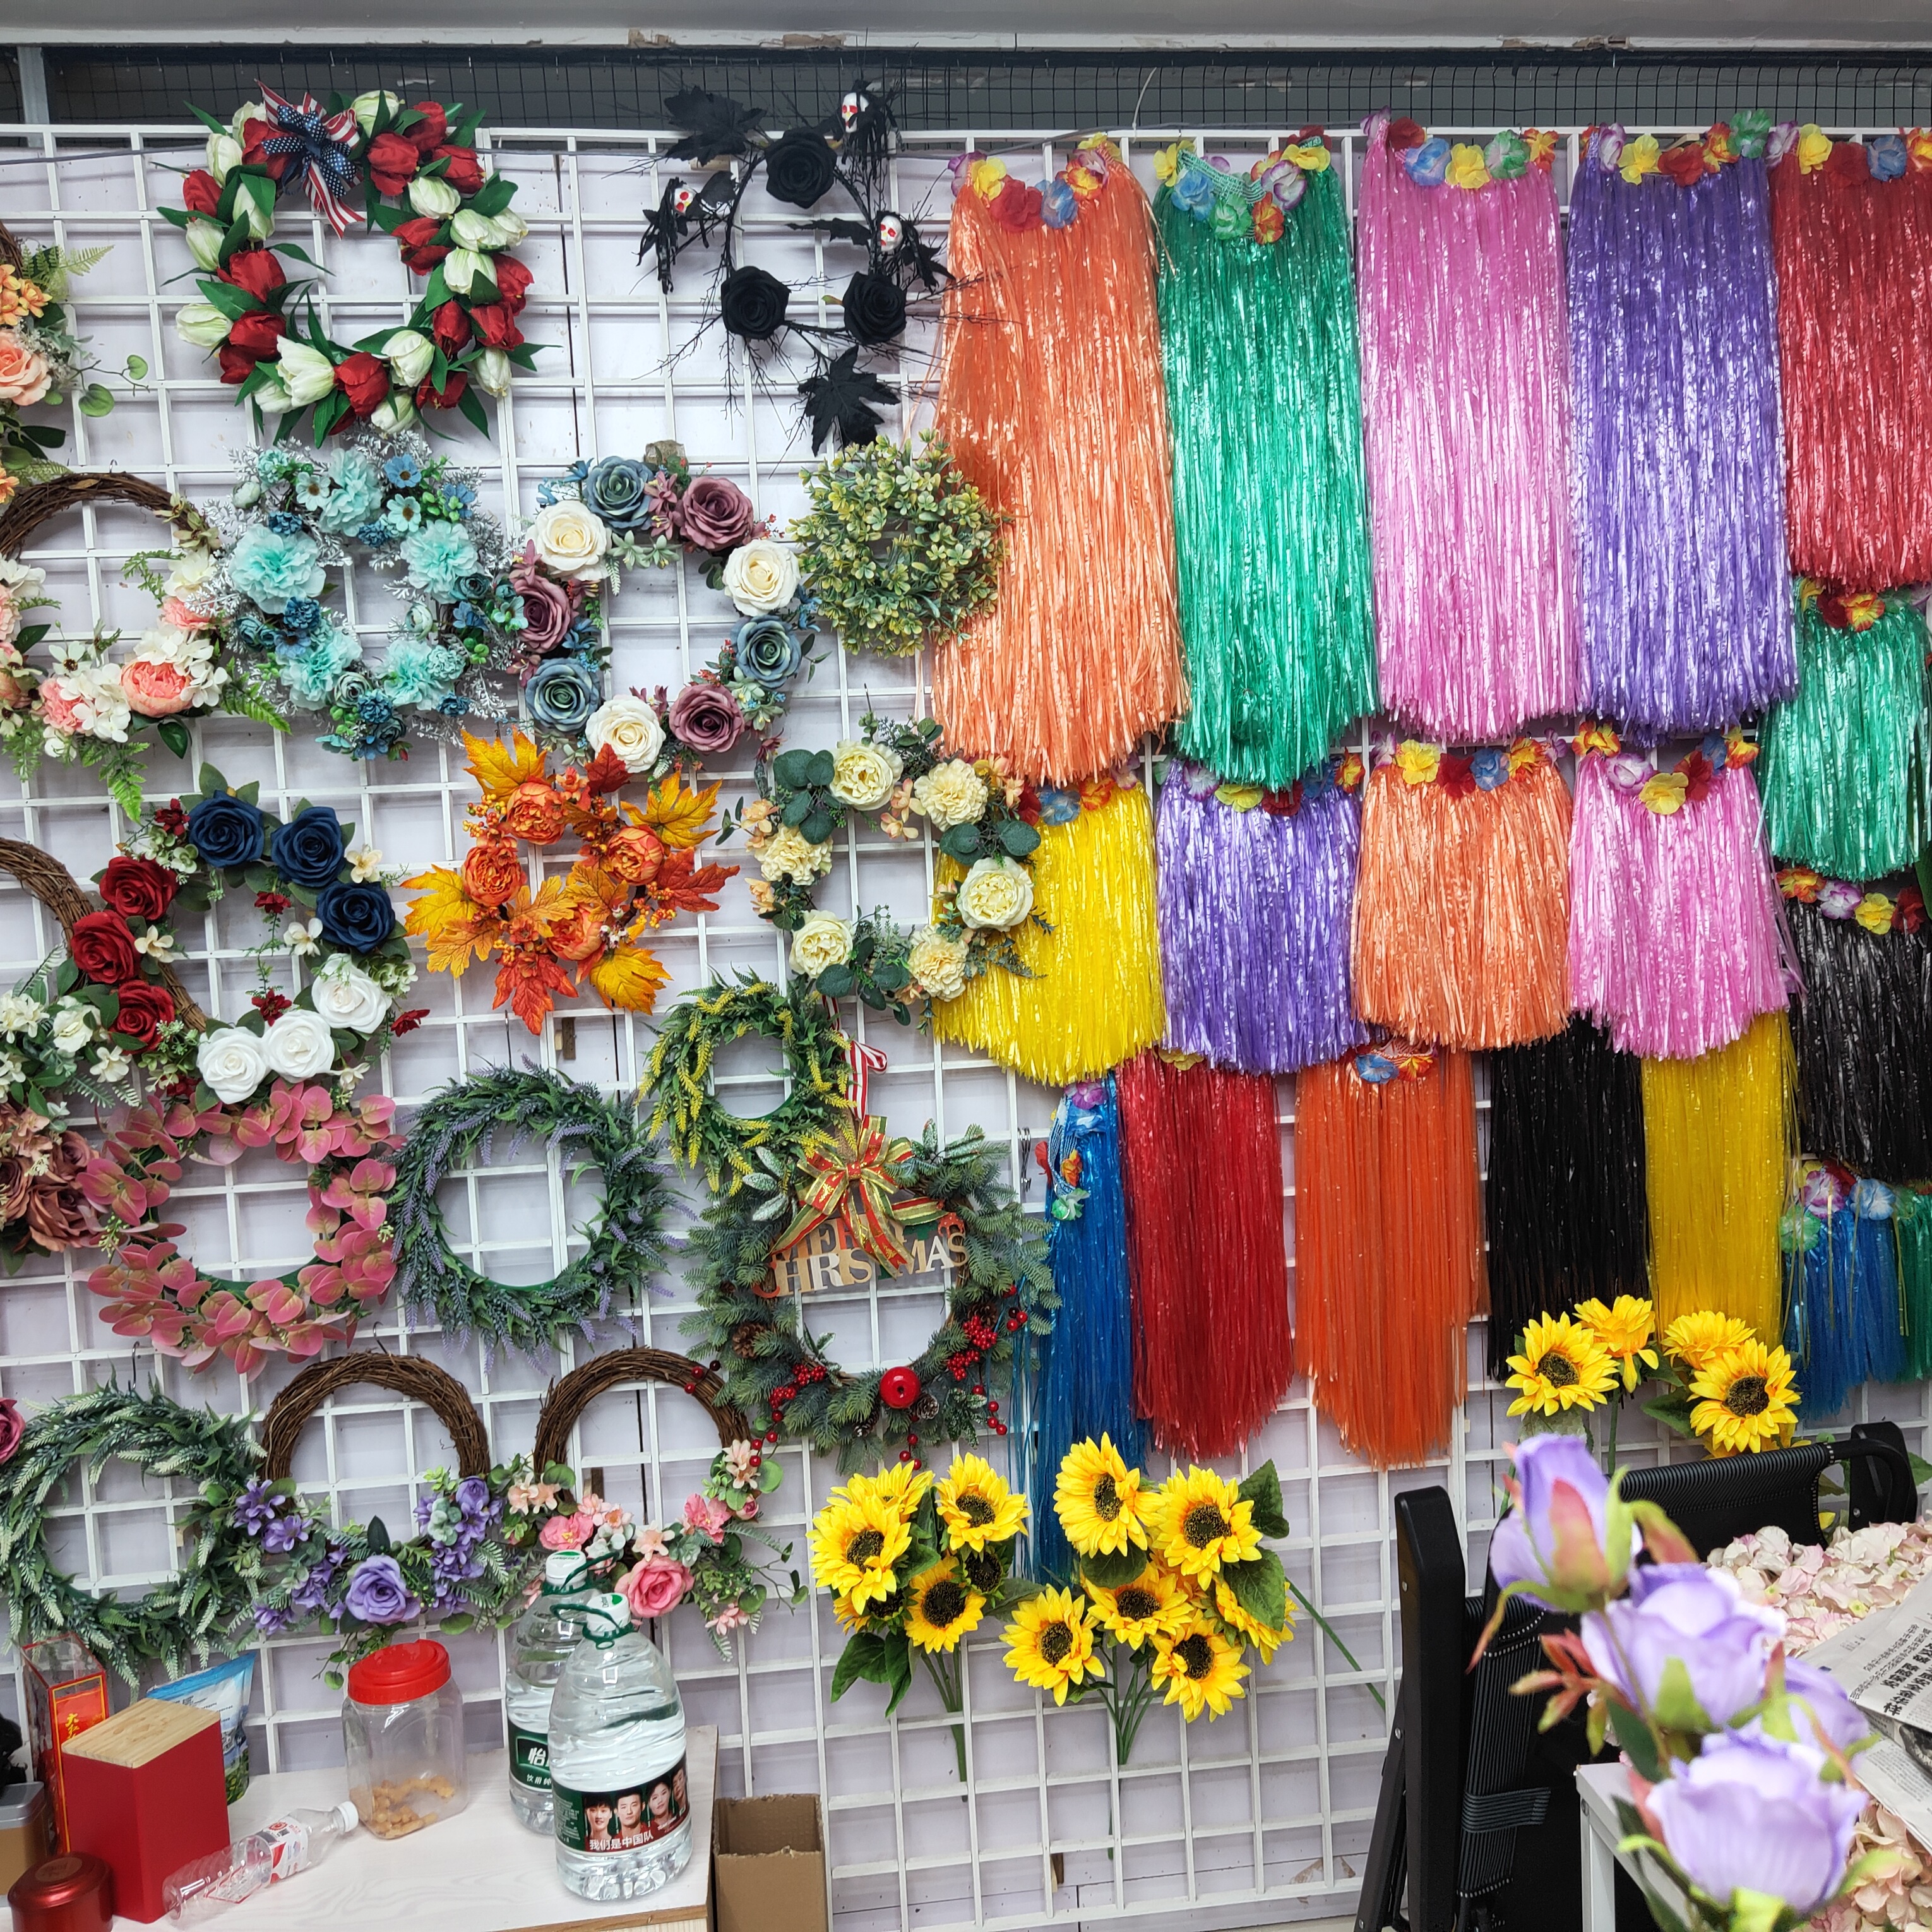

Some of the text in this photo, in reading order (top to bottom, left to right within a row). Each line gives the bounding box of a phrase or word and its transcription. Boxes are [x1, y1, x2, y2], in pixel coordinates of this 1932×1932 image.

[528, 1747, 549, 1767] 怡
[589, 1829, 653, 1851] 我们是中国队
